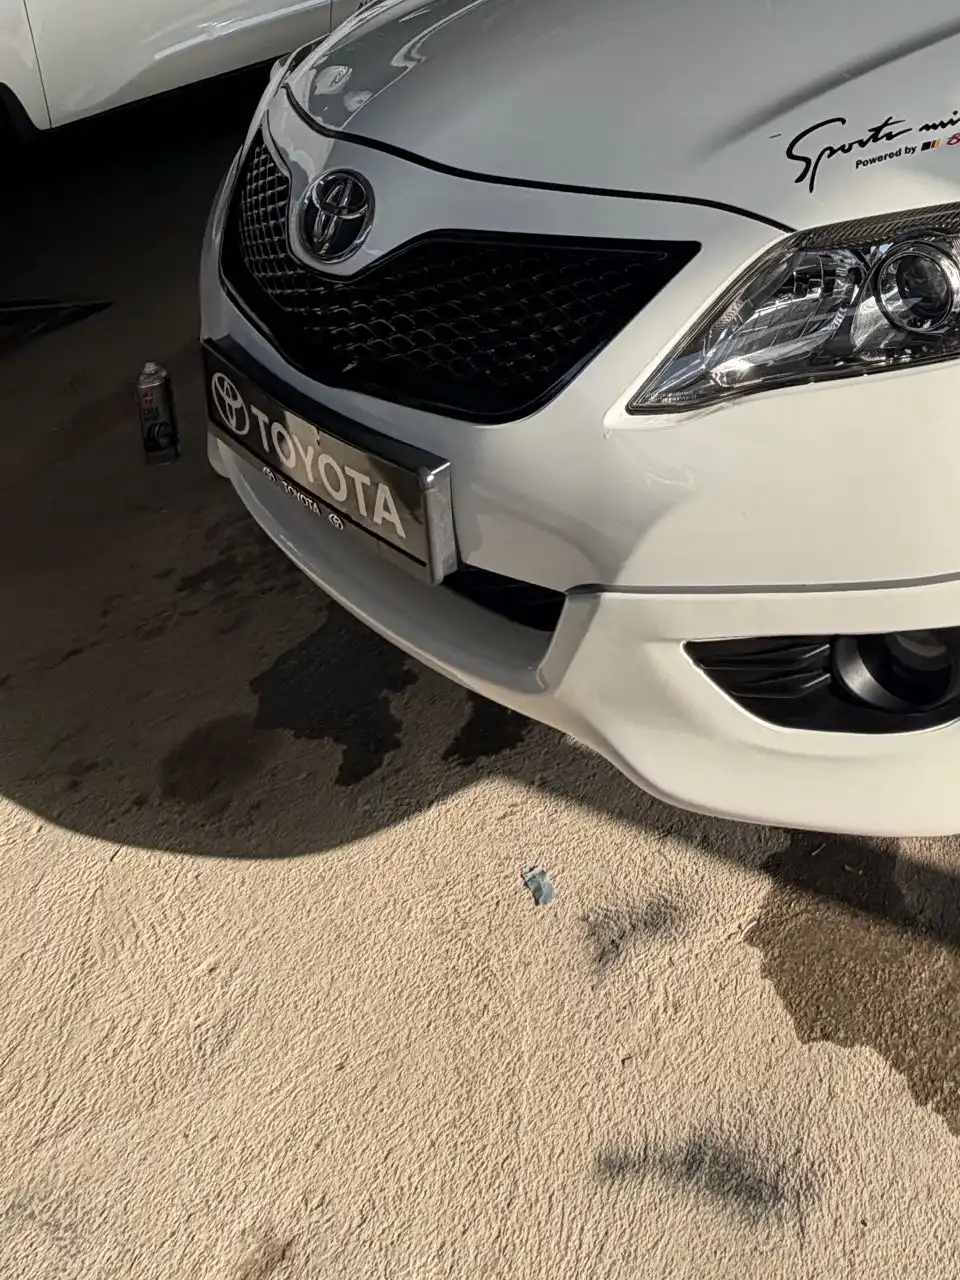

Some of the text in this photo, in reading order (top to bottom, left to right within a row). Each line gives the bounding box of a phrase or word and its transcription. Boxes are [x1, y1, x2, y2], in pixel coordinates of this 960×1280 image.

[855, 148, 902, 170] Powered
[904, 144, 918, 157] by
[250, 403, 407, 540] TOYOTA
[282, 480, 322, 517] TOYOTA
